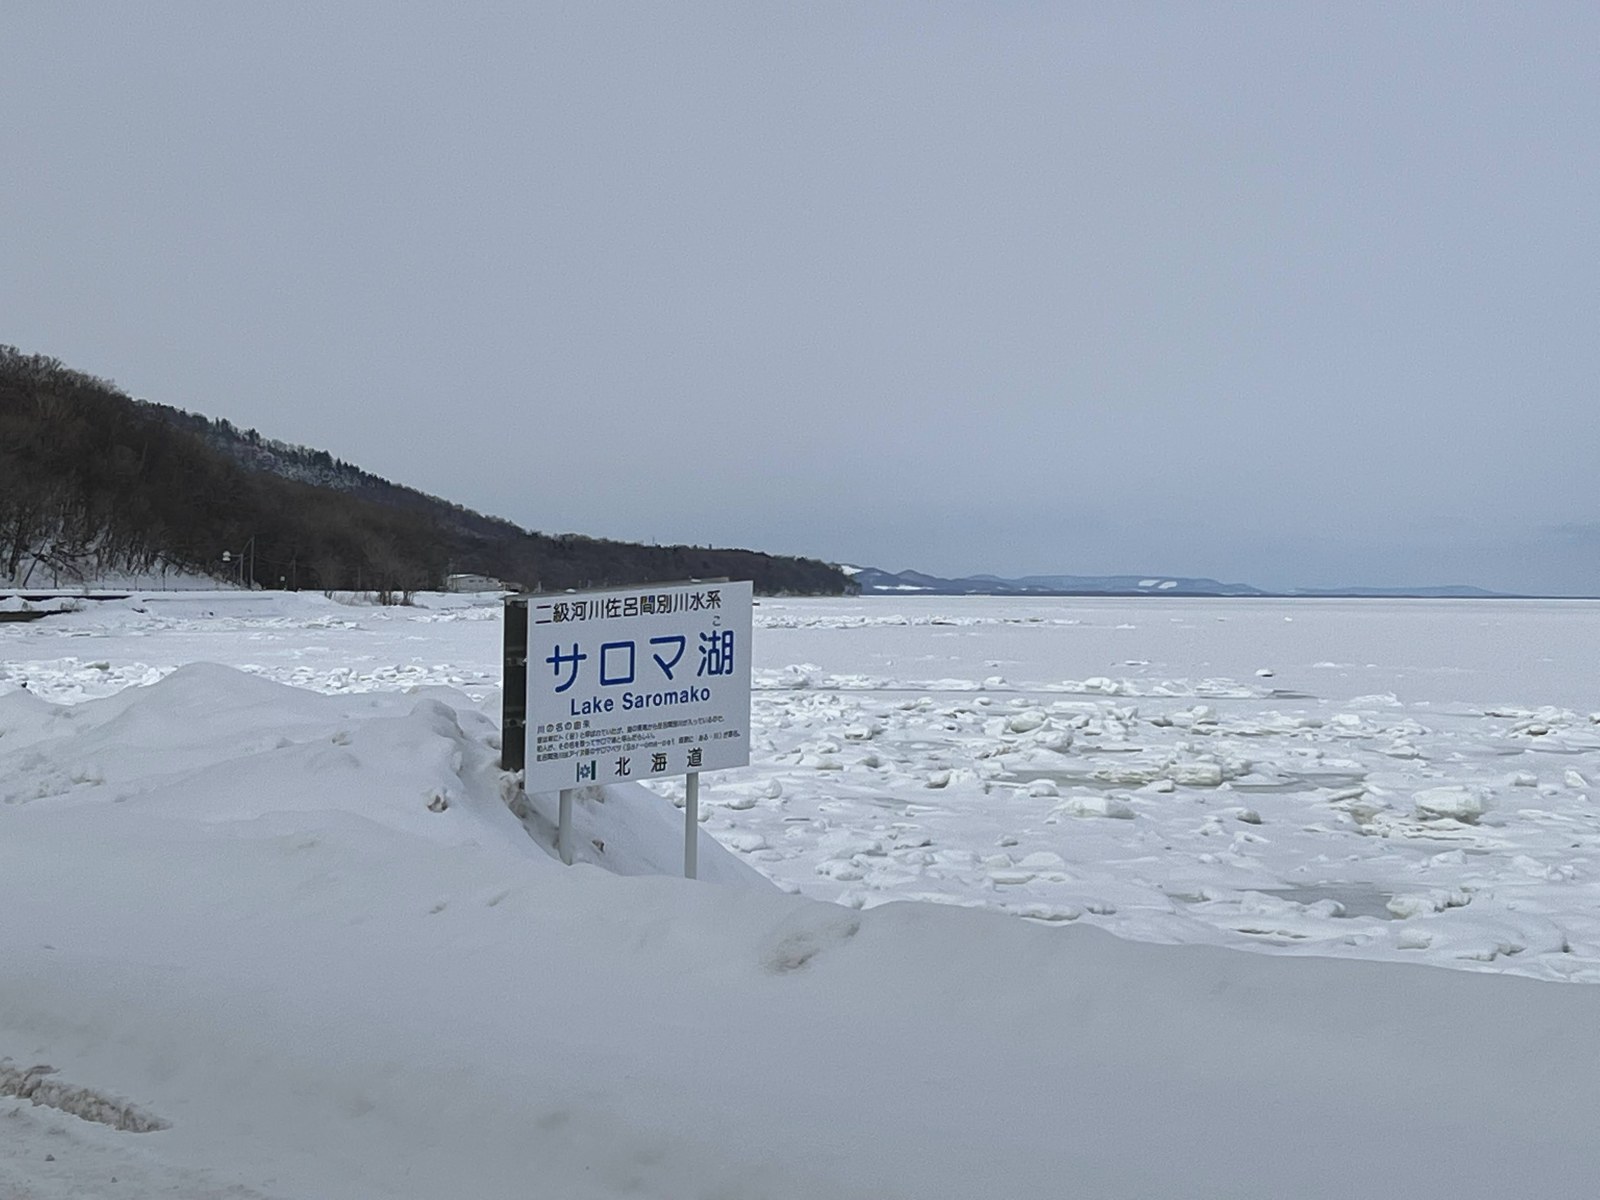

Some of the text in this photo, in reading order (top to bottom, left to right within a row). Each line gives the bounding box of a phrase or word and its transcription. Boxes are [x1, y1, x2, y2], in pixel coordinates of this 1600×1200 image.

[535, 589, 721, 624] 二級河川佐呂間別川水系
[712, 616, 721, 627] こ
[546, 630, 734, 693] サロマ湖
[571, 685, 711, 716] Lake Saromako
[615, 747, 703, 776] 北海道
